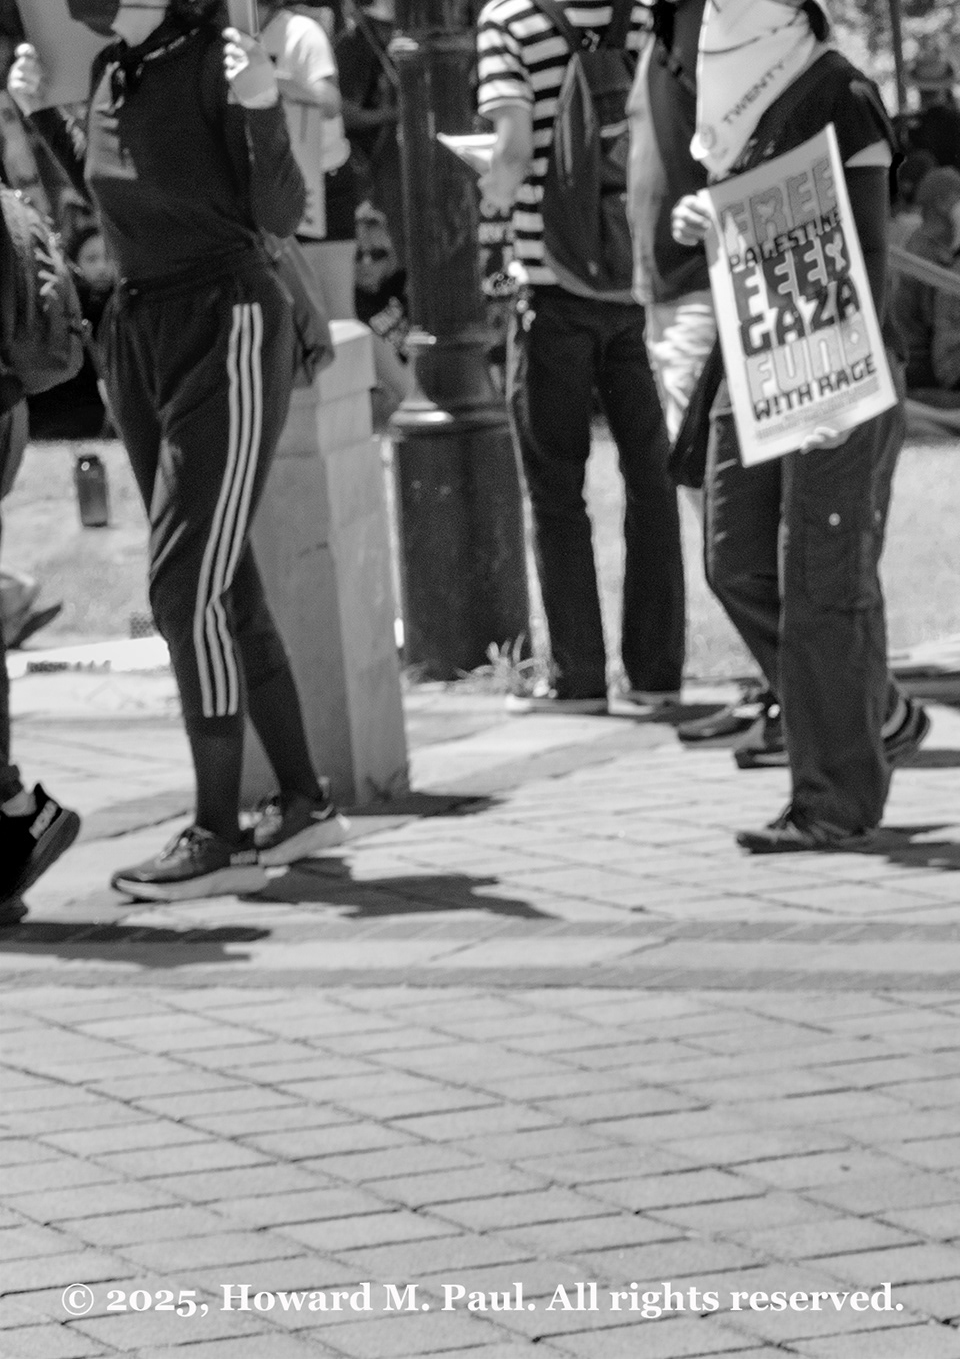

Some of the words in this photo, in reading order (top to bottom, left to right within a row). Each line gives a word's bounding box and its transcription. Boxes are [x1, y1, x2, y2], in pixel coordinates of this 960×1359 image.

[722, 59, 784, 125] TWENTY
[720, 156, 838, 243] FREE
[740, 278, 860, 357] GAZA
[819, 353, 877, 396] RAGE
